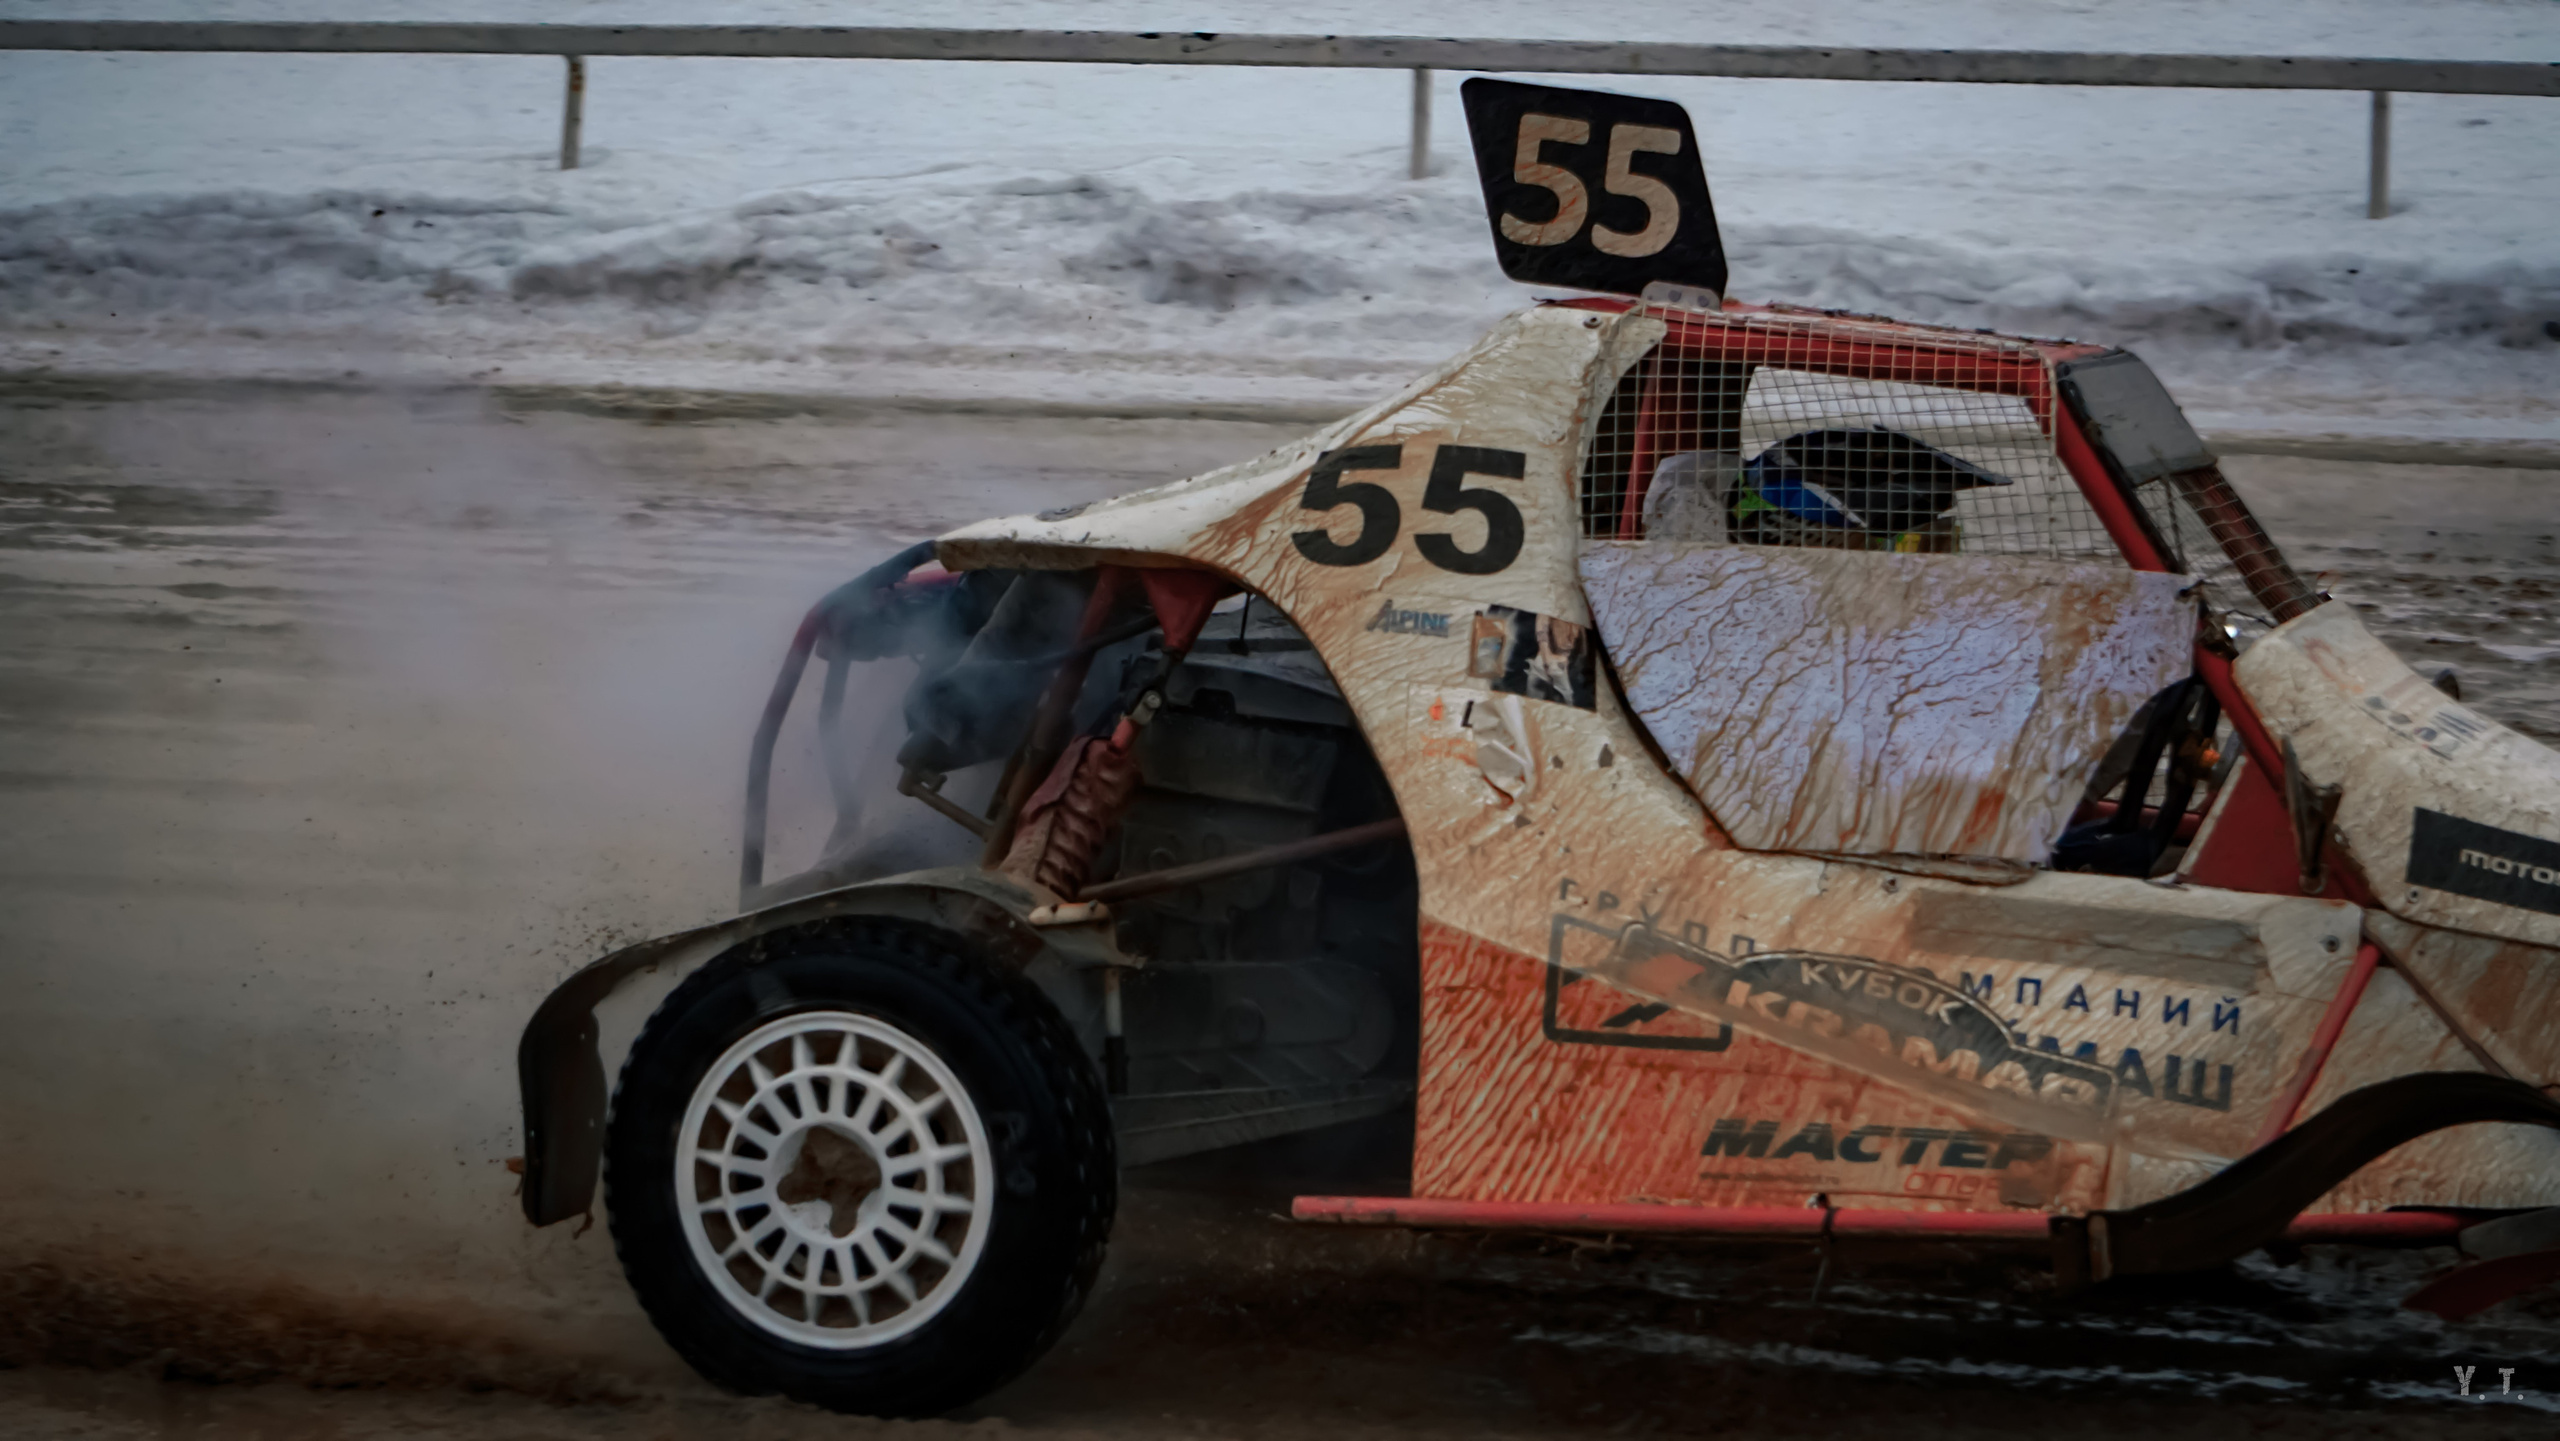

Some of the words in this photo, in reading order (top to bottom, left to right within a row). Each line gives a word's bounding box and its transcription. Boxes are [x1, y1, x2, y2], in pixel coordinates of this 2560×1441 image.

[1500, 112, 1682, 259] 55
[1291, 443, 1527, 576] 55
[2460, 848, 2560, 888] moto
[1559, 876, 1756, 958] ГРУПП
[1912, 966, 2241, 1036] МПАНИЙ
[1801, 961, 1965, 1026] КУБОК
[1701, 1118, 2053, 1170] МАСТЕР
